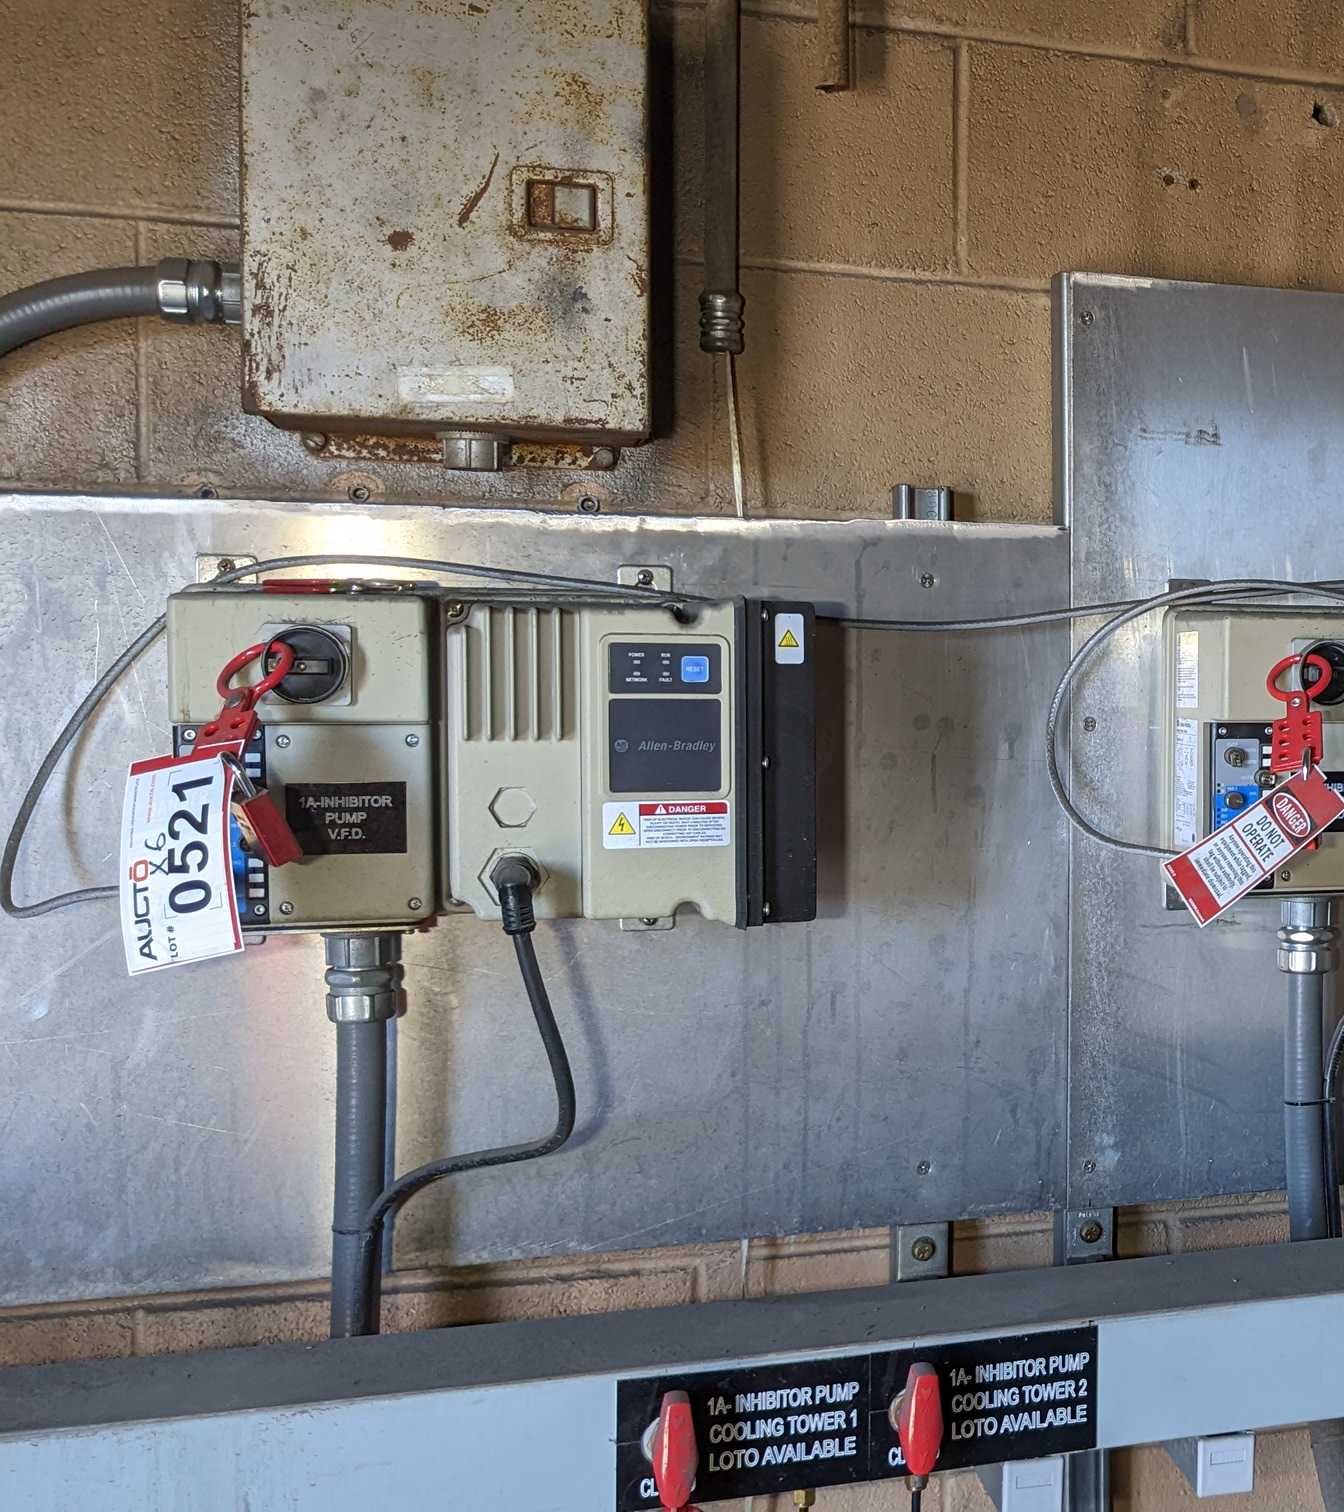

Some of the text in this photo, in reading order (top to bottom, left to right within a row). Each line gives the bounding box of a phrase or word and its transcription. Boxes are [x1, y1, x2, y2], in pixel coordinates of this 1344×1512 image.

[638, 740, 716, 753] Allen-Bradley
[299, 796, 393, 809] 1A-INHIBITOR
[325, 811, 368, 824] PUMP
[668, 805, 706, 814] DANGER
[1276, 797, 1307, 834] DANGER
[167, 775, 214, 914] 0521
[327, 828, 366, 840] V.F.D.
[1242, 823, 1274, 863] OPERATE
[1256, 815, 1285, 849] DO NOT
[168, 936, 179, 961] LOT
[949, 1352, 1090, 1387] 1A- INHIBITOR PUMP
[707, 1381, 860, 1416] 1A- INHIBITOR PUMP
[951, 1378, 1088, 1413] COOLING TOWER 2
[709, 1408, 858, 1444] COOLING TOWER 1
[951, 1404, 1088, 1441] LOTO AVAILABLE
[709, 1447, 760, 1473] LOTO
[761, 1436, 857, 1467] AVAILABLE
